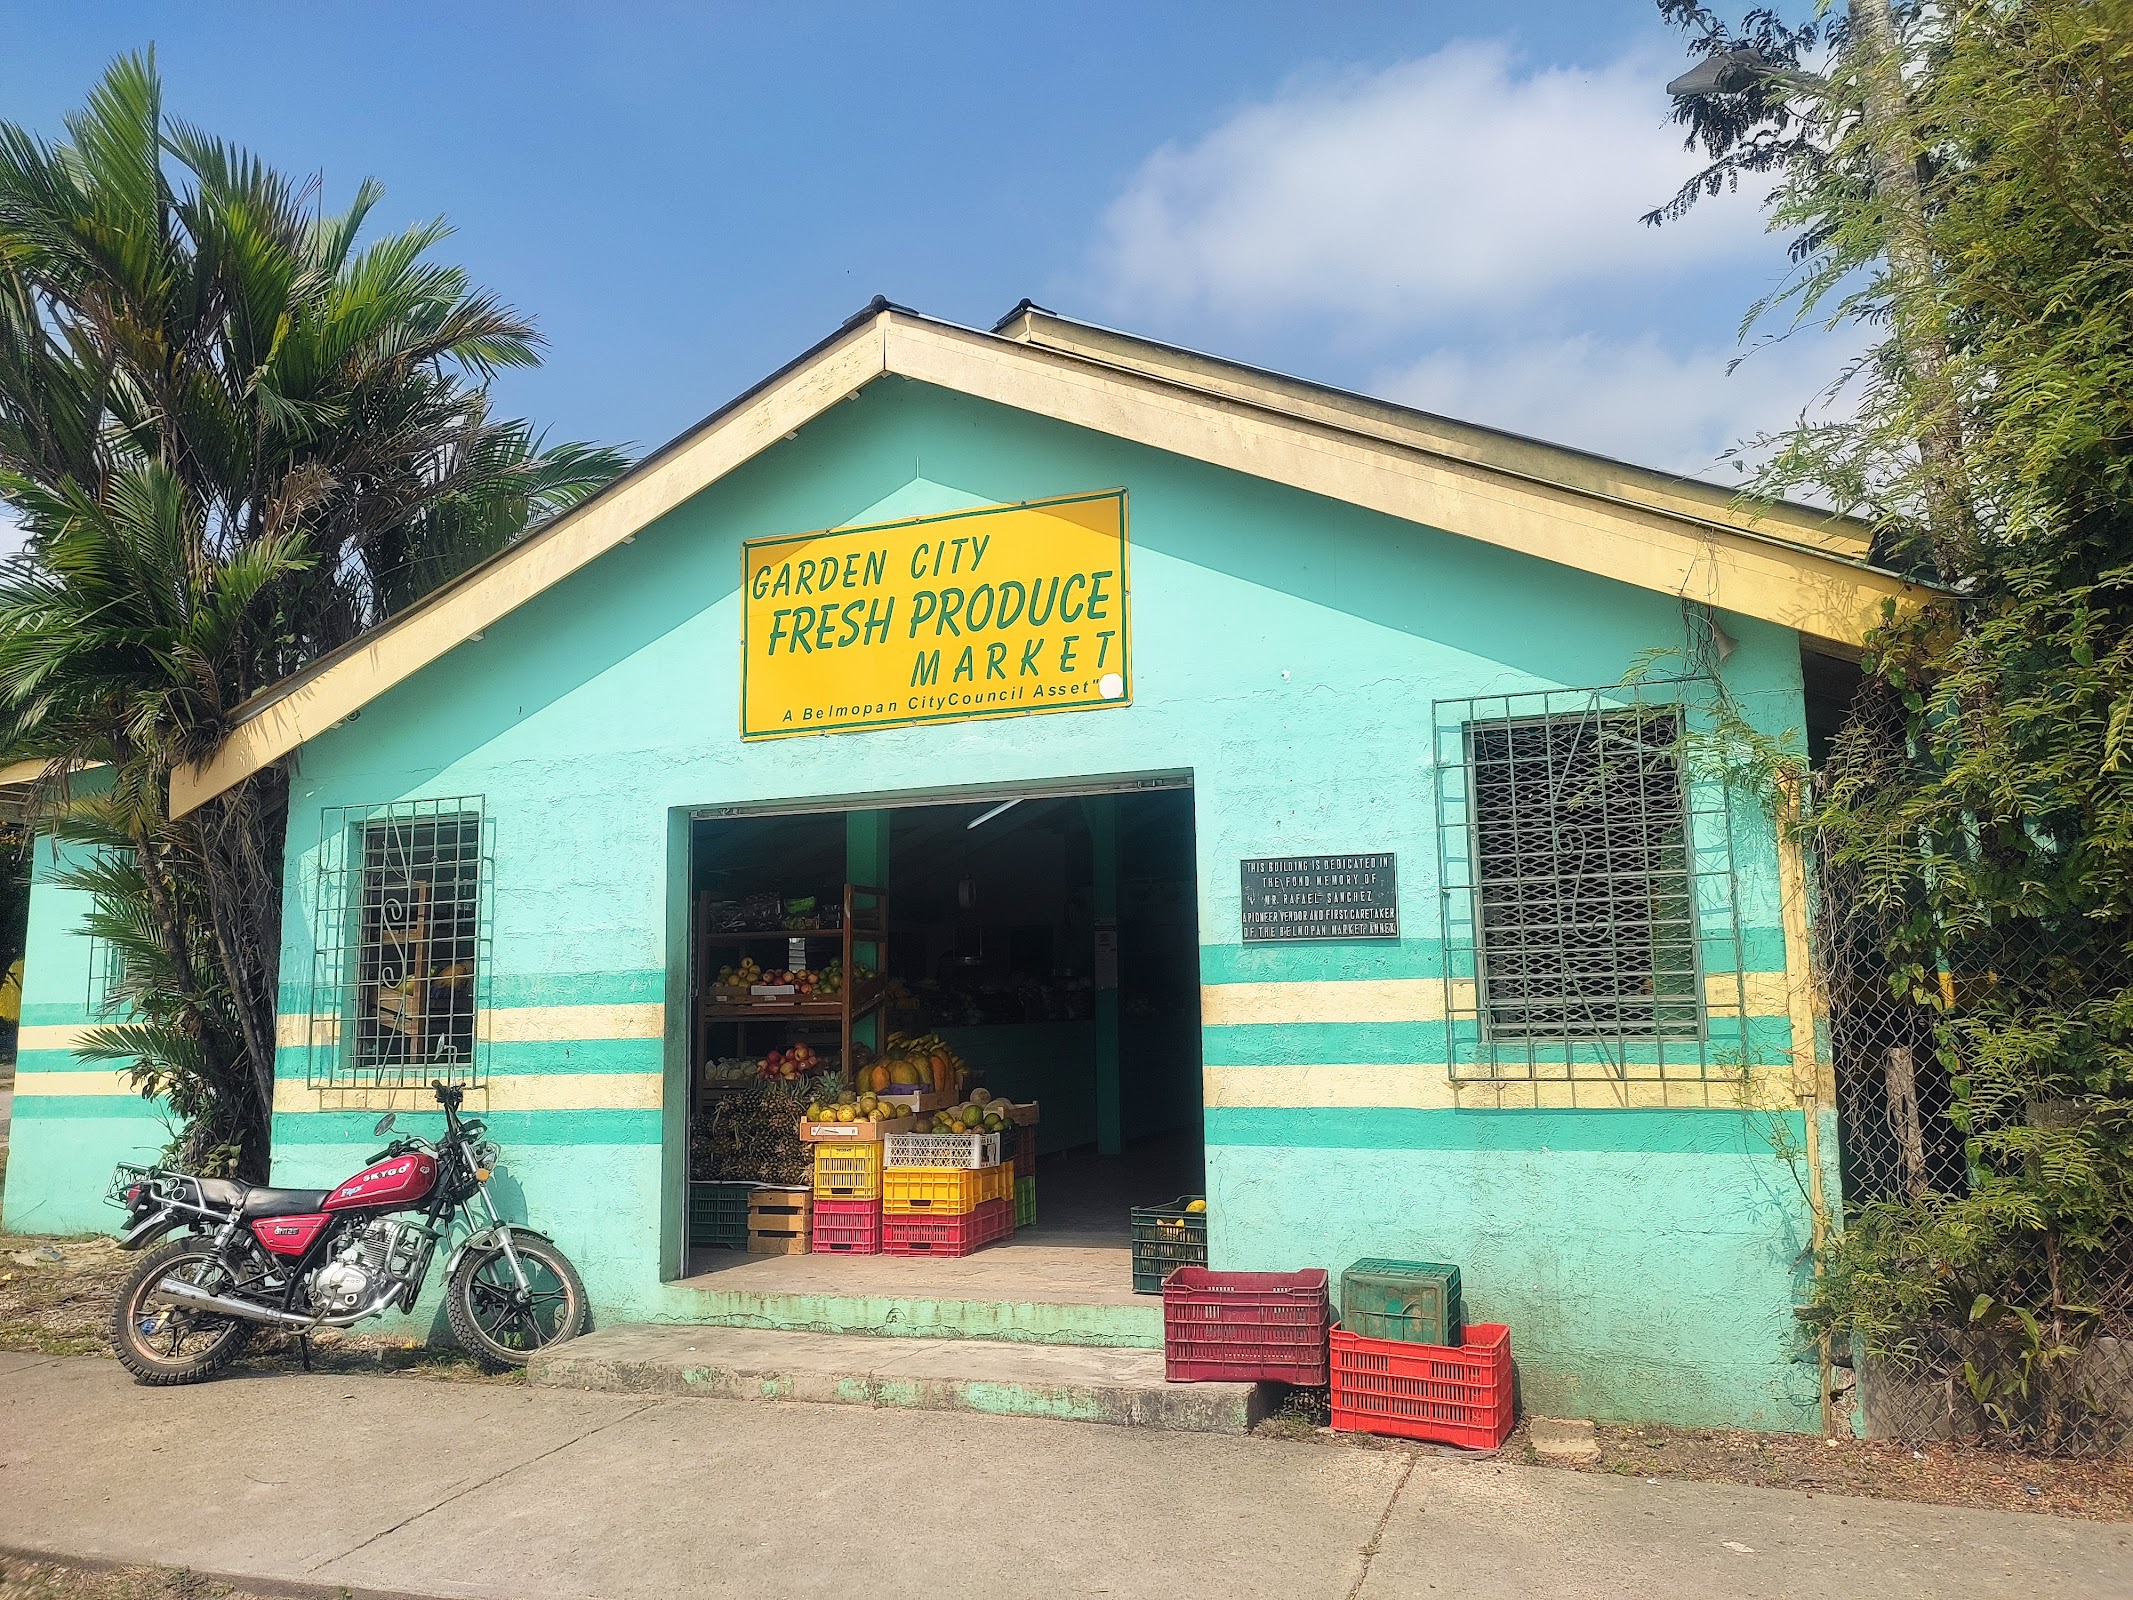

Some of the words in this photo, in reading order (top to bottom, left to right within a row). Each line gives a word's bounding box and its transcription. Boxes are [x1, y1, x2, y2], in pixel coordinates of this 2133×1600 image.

[753, 550, 887, 600] GARDEN
[910, 534, 991, 579] CITY
[768, 596, 896, 656] FRESH
[909, 570, 1113, 638] PRODUCE
[910, 630, 1116, 687] MARKET
[782, 709, 793, 722] A
[802, 700, 897, 720] Belmopan
[1247, 862, 1265, 873] THIS
[1268, 861, 1308, 872] BUILDING
[1312, 860, 1320, 870] IS
[1324, 857, 1376, 869] DEDICATED
[1379, 857, 1388, 868] IN
[1263, 877, 1279, 888] THE
[1286, 876, 1309, 887] FOND
[1316, 874, 1358, 886] MEMORY
[1364, 873, 1376, 884] OF
[1283, 893, 1320, 905] RAFAEL
[1327, 891, 1373, 904] SANCHEZ
[1248, 911, 1278, 923] PIONEER
[1279, 910, 1308, 922] VENDOR
[1309, 909, 1323, 921] AND
[1326, 909, 1348, 920] FIRST
[1350, 908, 1395, 920] CARETAKER
[1243, 927, 1254, 938] OF
[1259, 926, 1276, 937] THE
[1280, 925, 1326, 937] BELMOPAN
[1331, 923, 1364, 935] MARKET
[363, 1164, 407, 1182] SKYGO
